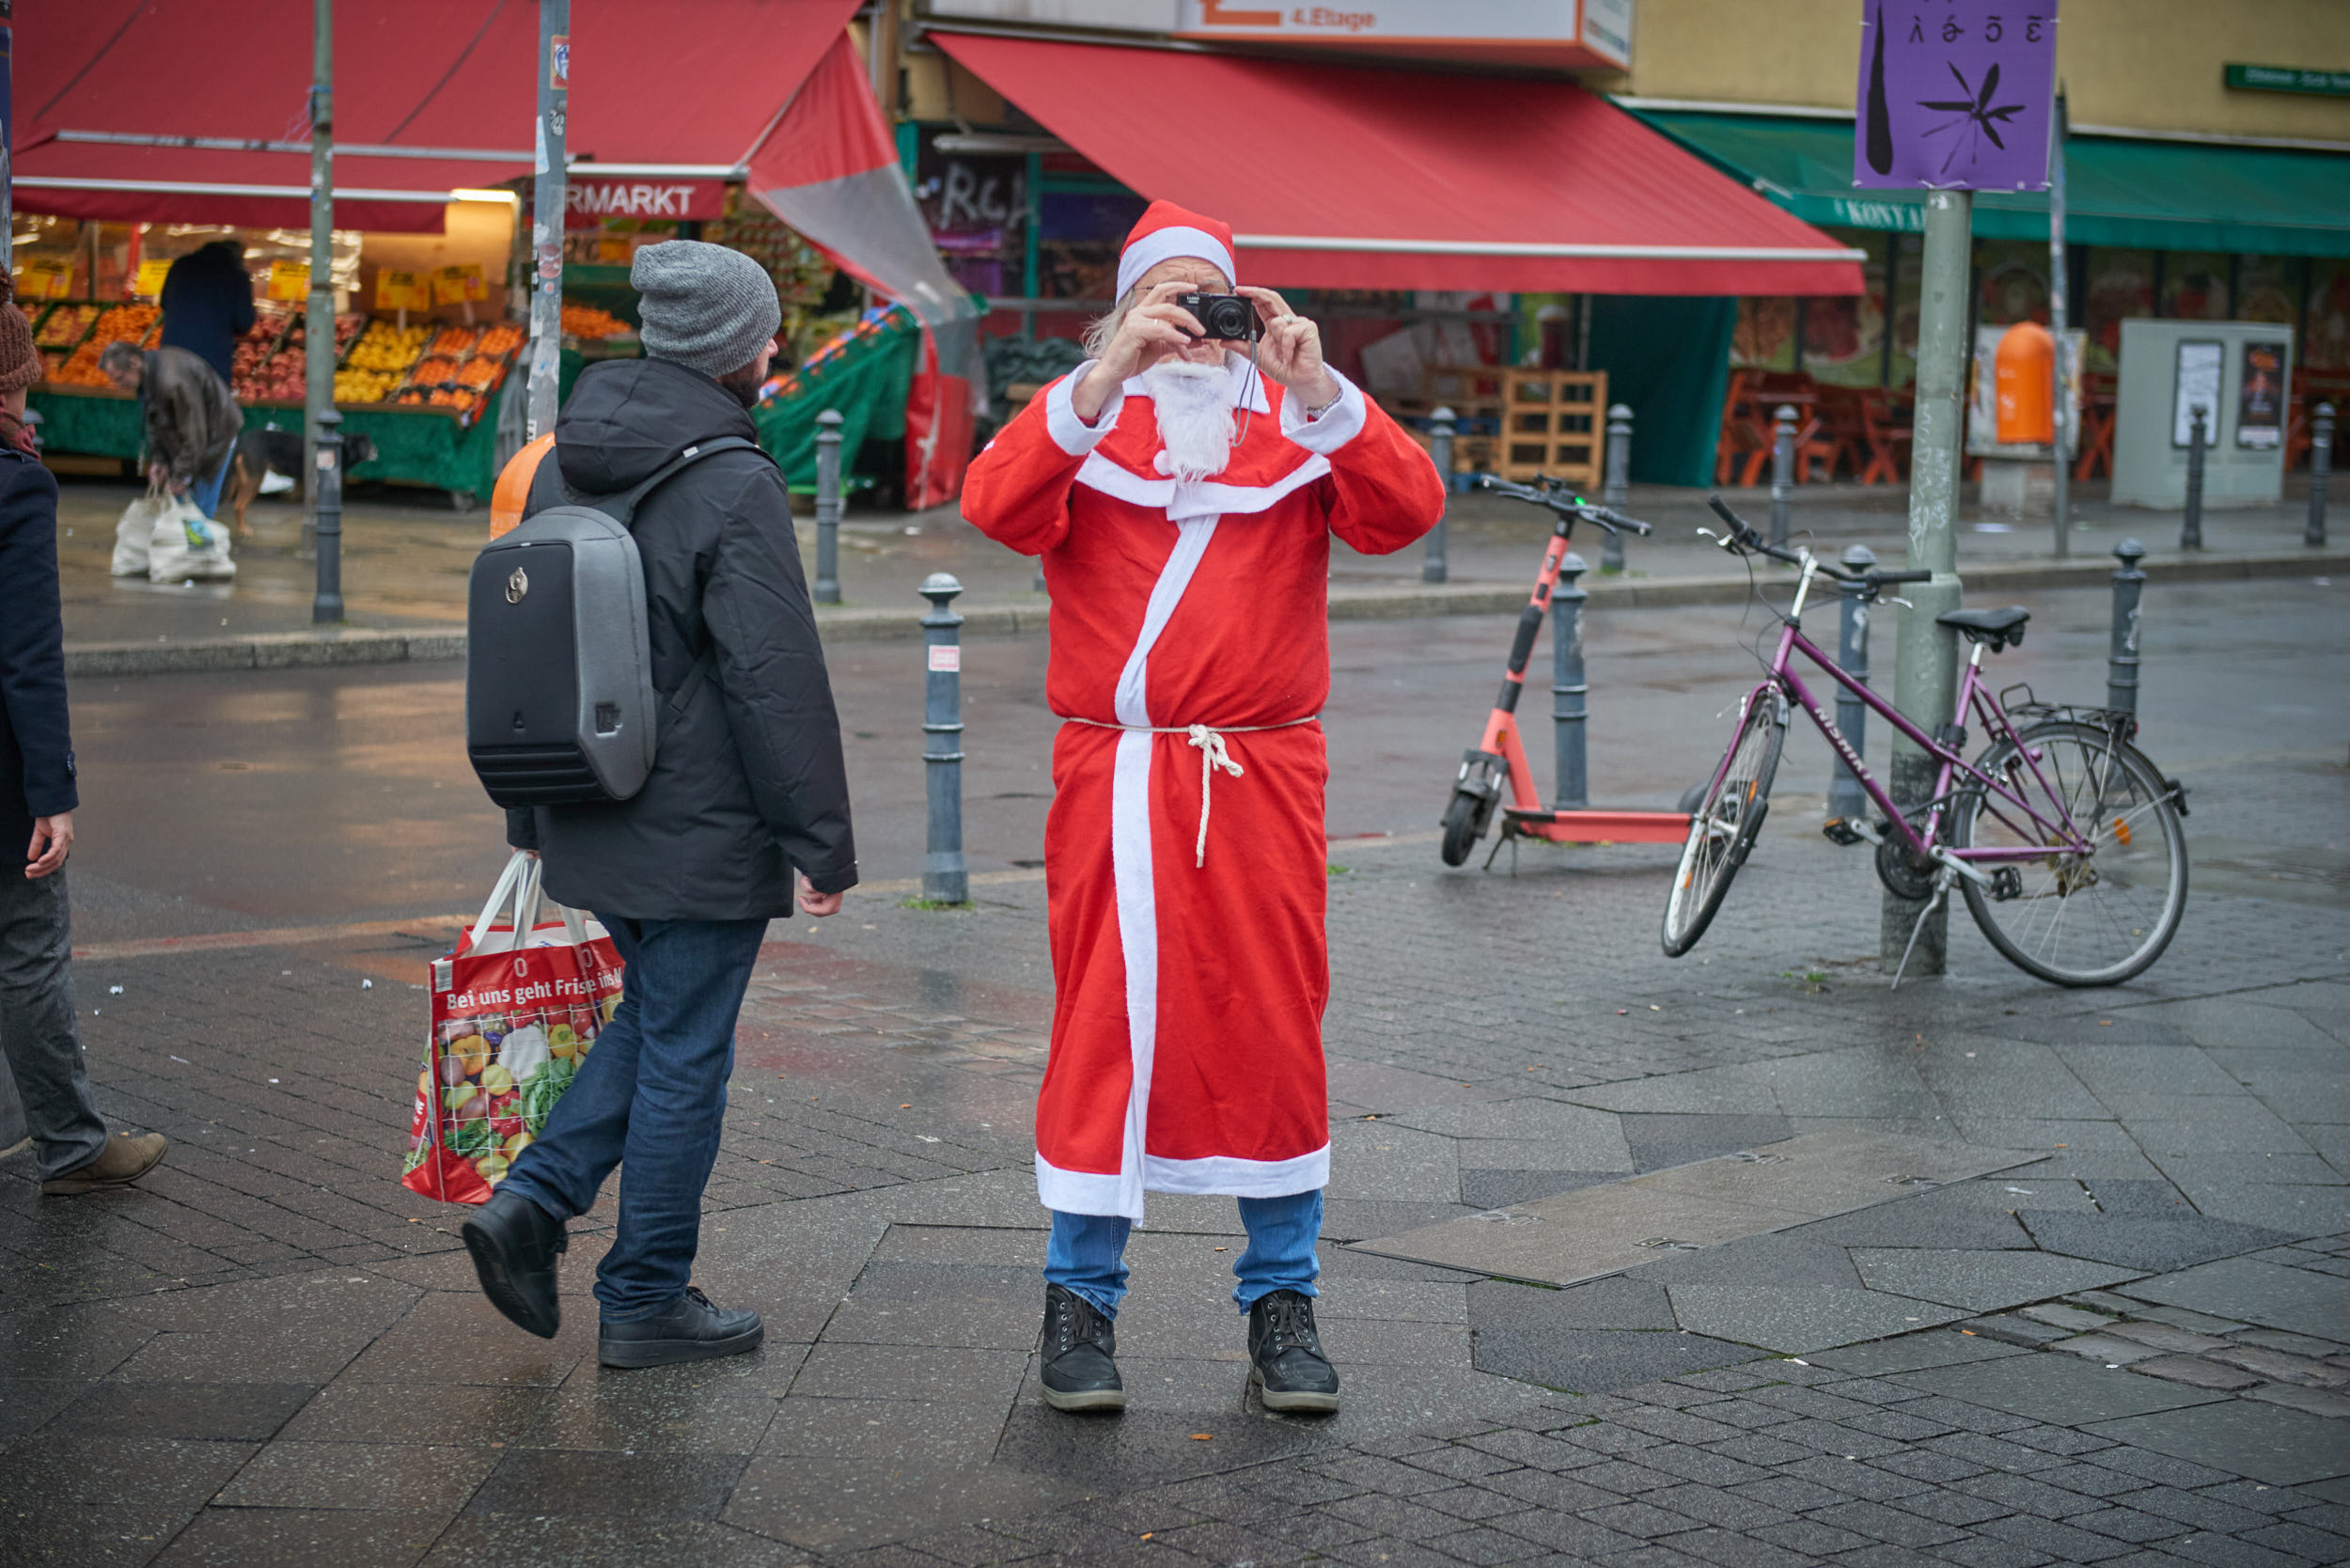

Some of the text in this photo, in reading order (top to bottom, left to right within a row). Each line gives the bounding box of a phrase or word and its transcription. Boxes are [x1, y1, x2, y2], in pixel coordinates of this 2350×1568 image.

[565, 185, 696, 215] RMARKT
[1814, 707, 1872, 780] NISHIKI
[446, 990, 475, 1010] Bei
[479, 990, 510, 1005] uns
[516, 980, 552, 1005] geht
